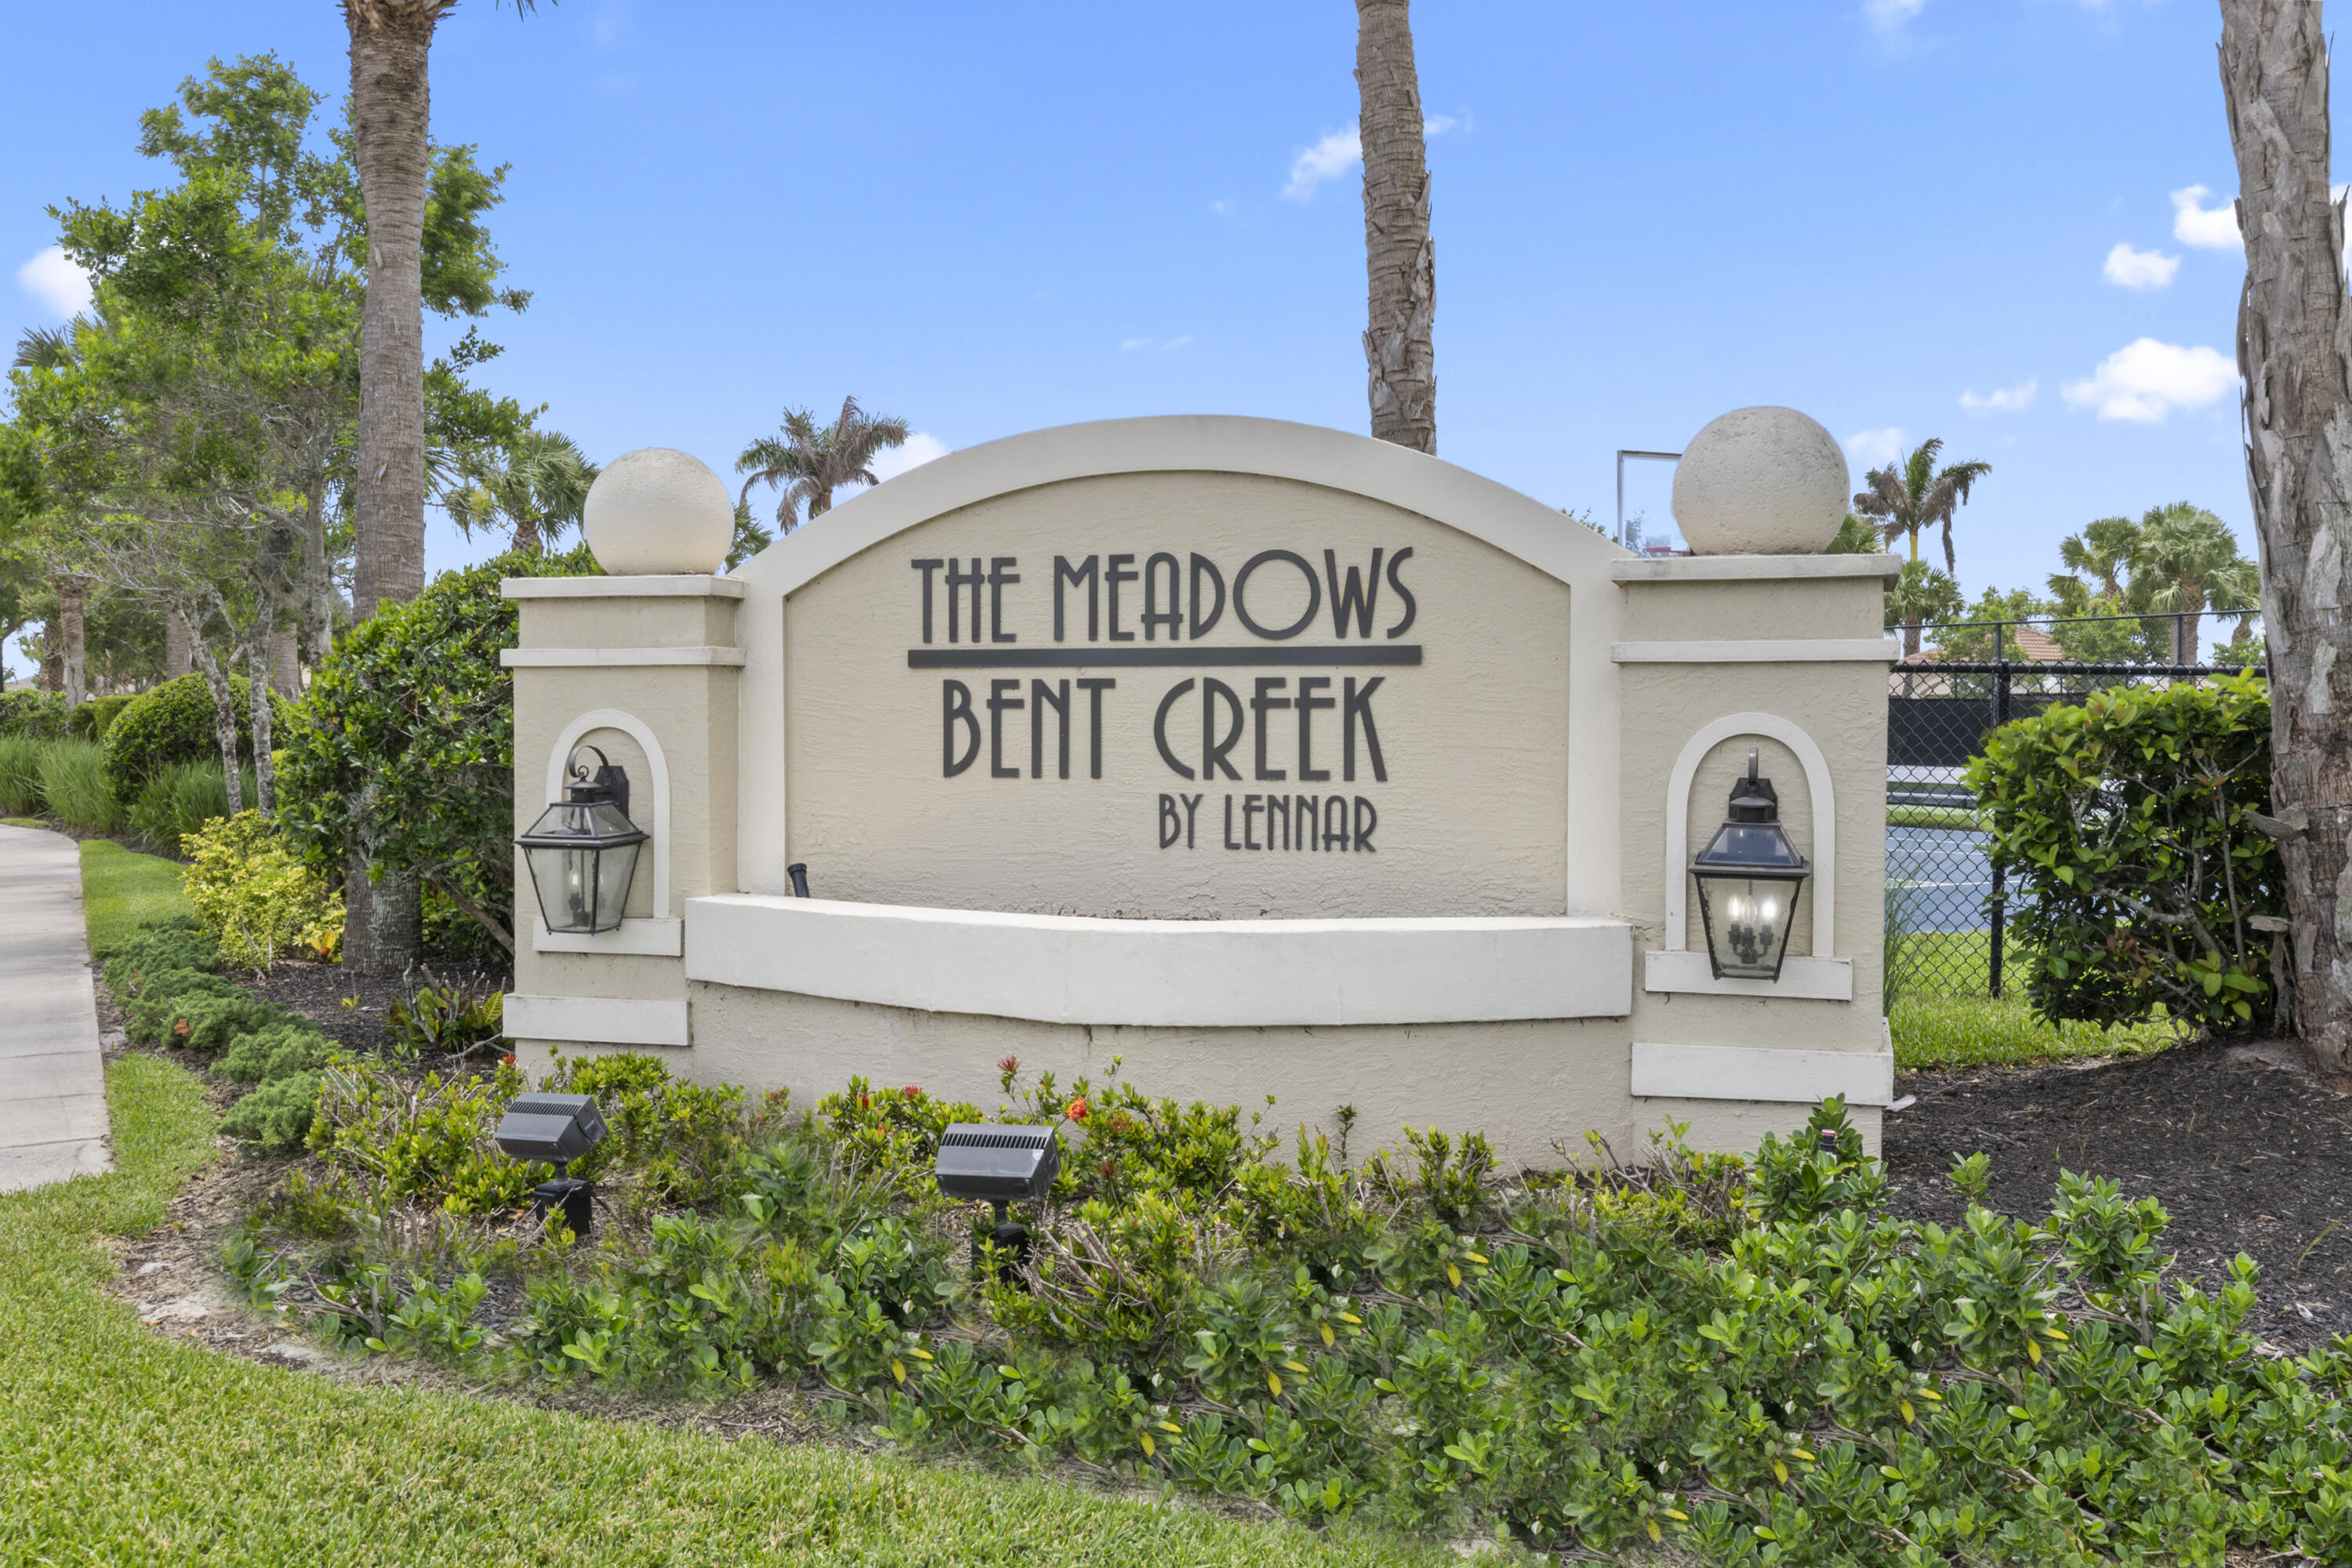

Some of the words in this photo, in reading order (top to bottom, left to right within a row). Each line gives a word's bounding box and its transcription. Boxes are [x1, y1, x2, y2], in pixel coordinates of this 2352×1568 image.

[911, 557, 1021, 644] THE
[1054, 546, 1417, 643] MEADOWS
[942, 677, 1116, 780] BENT
[1153, 677, 1388, 782] CREEK
[1159, 793, 1203, 850] BY
[1224, 794, 1377, 853] LENNAR
